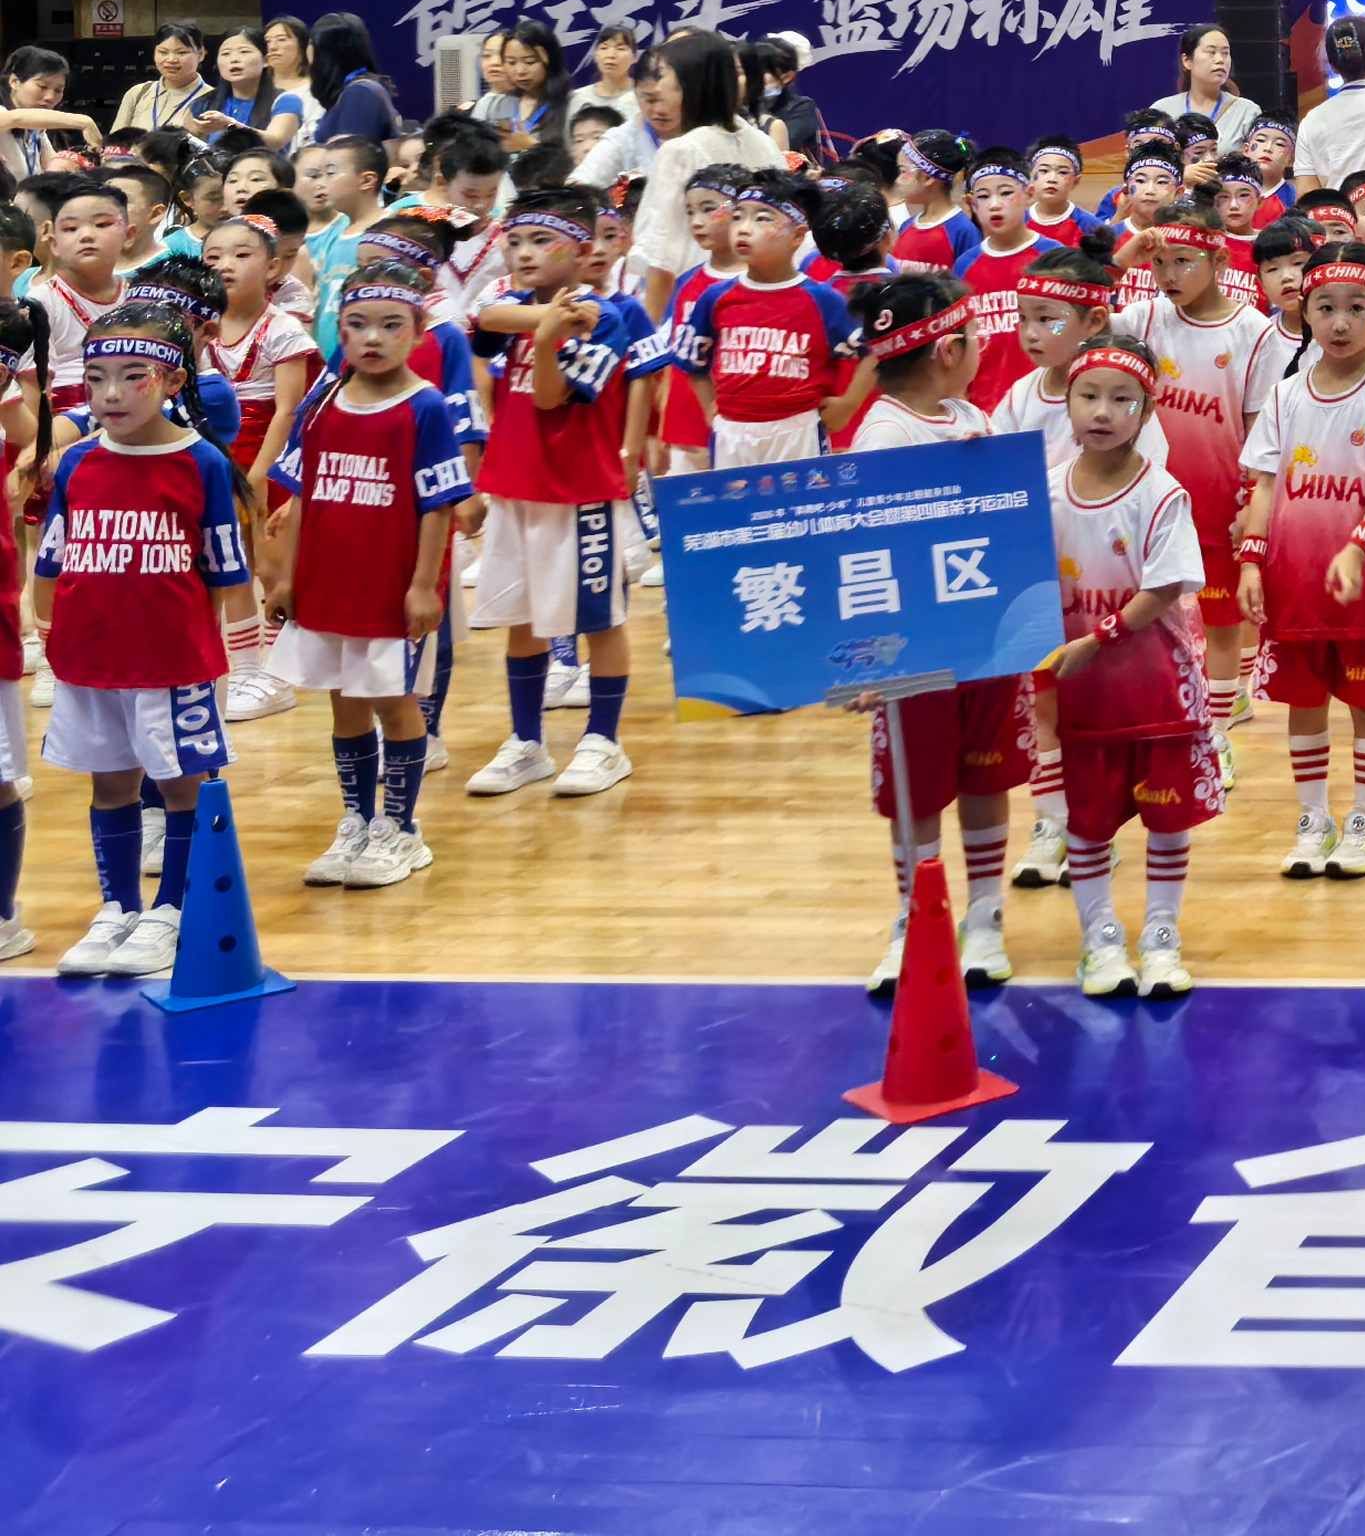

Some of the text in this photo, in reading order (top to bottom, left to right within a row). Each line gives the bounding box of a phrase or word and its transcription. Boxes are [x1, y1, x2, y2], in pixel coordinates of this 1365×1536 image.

[316, 450, 390, 481] ATIONAL
[71, 509, 186, 542] NATIONAL
[140, 543, 193, 575] IONS
[731, 536, 999, 634] 繁昌区
